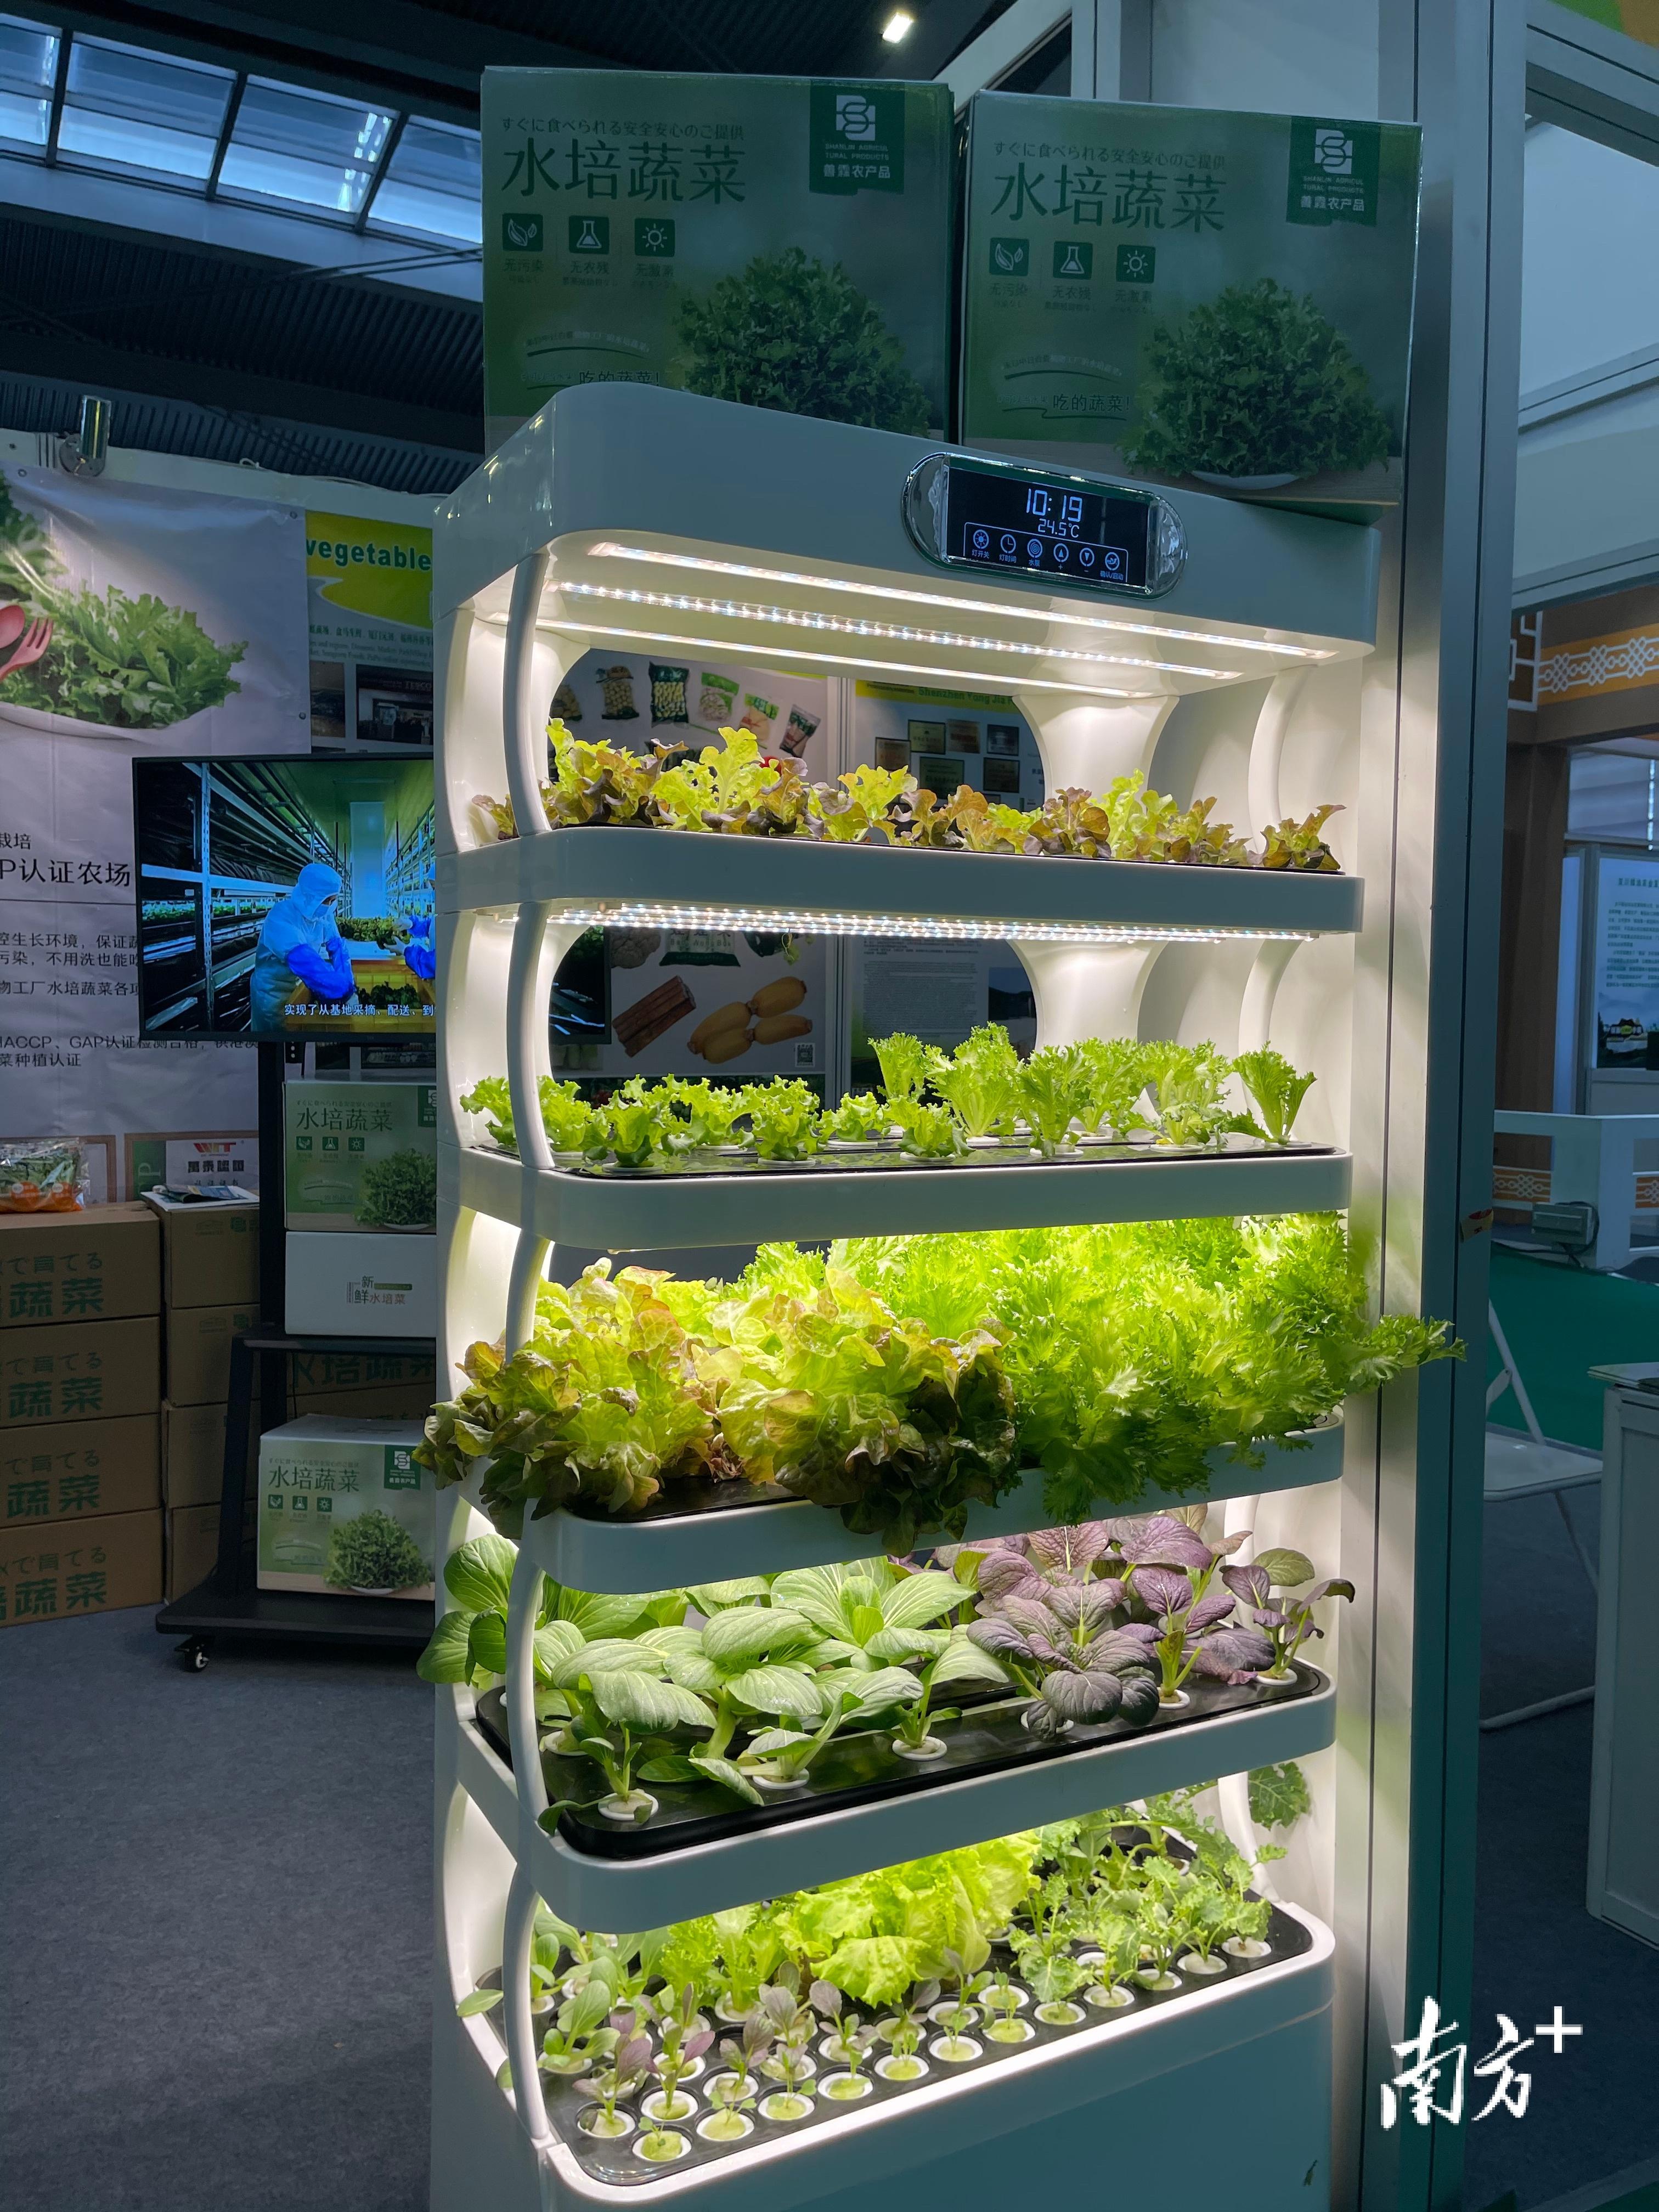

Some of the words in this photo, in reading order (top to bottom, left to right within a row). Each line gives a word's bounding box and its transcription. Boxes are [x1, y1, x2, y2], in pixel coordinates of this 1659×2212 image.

[501, 137, 746, 205] 水培蔬菜
[991, 162, 1227, 233] 水培蔬菜
[1026, 488, 1082, 522] 10:19
[306, 539, 431, 571] vegetable
[972, 549, 990, 559] 灯开关
[0, 858, 131, 887] P认证农场
[285, 1003, 437, 1016] 实现了从基地采摘、配送、到
[296, 1107, 393, 1132] 水培蔬菜
[0, 1252, 103, 1275] で育てる
[9, 1277, 104, 1318] 蔬菜
[8, 1376, 103, 1419] 蔬菜
[268, 1465, 360, 1493] 水培蔬菜
[7, 1474, 101, 1519] 蔬菜
